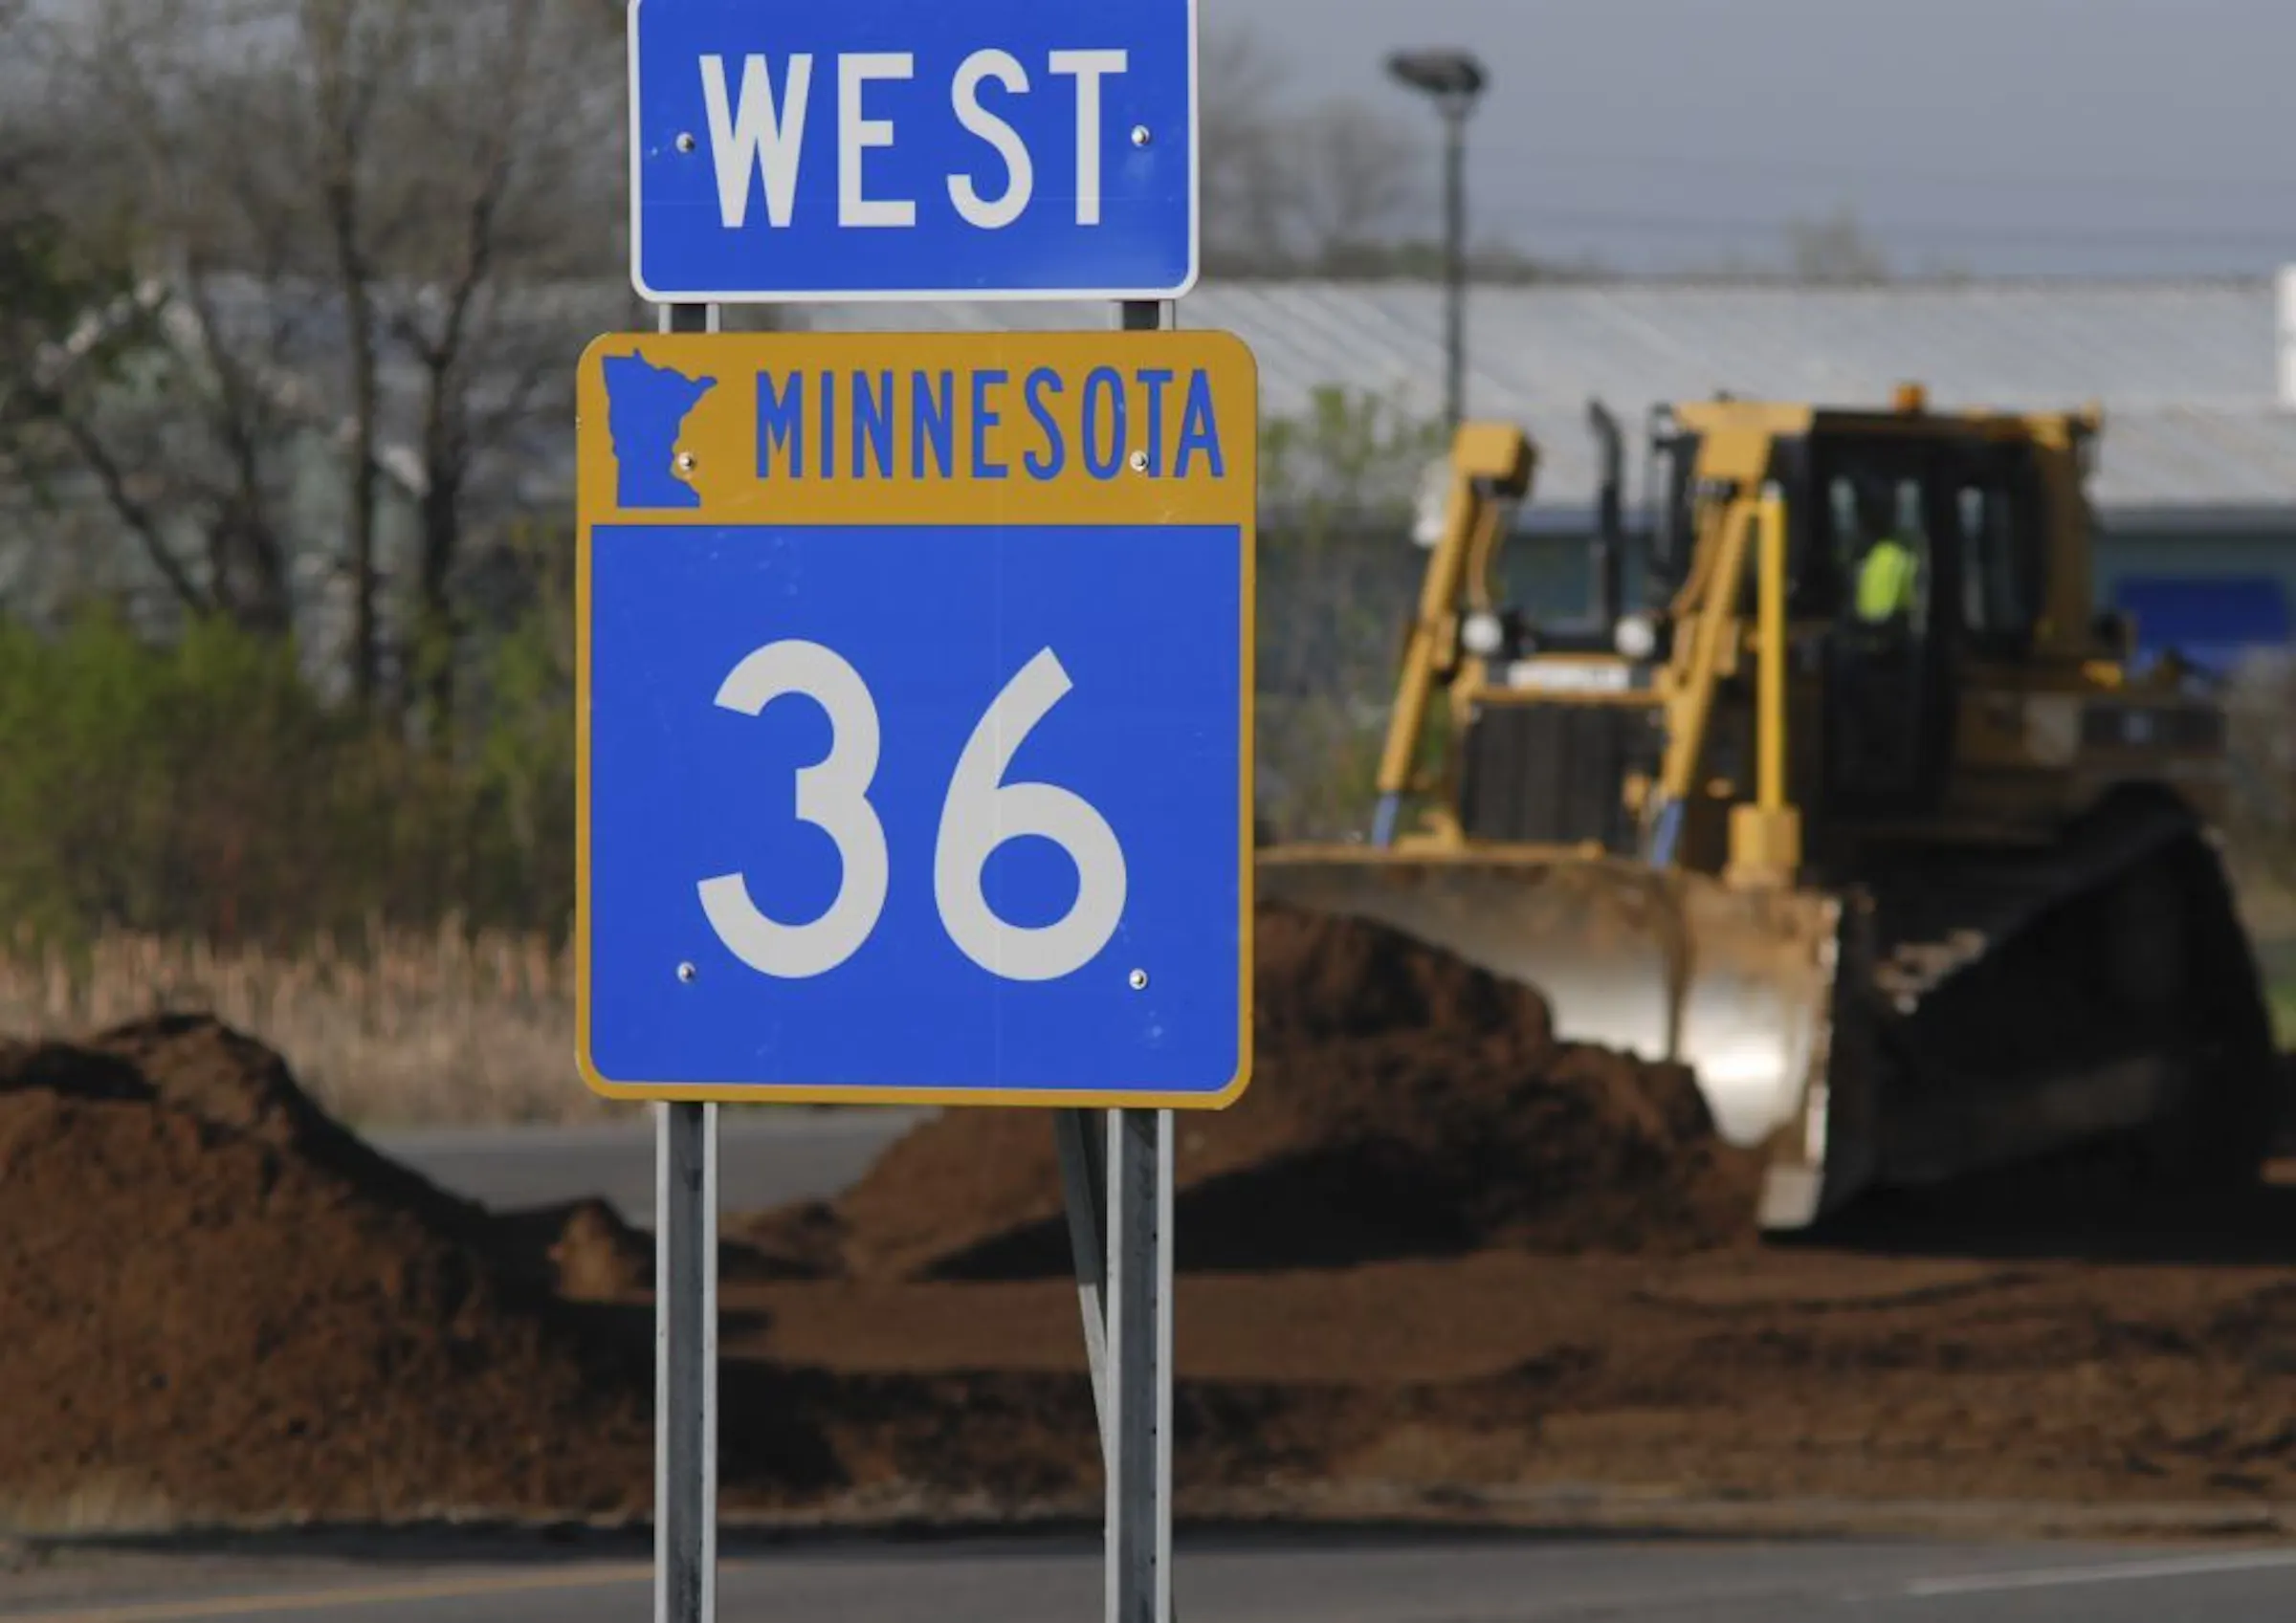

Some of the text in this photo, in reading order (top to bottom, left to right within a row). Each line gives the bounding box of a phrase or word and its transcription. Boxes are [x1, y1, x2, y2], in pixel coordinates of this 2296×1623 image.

[699, 49, 1127, 229] WEST
[756, 367, 1225, 480] MINNESOTA
[697, 639, 1127, 981] 36
